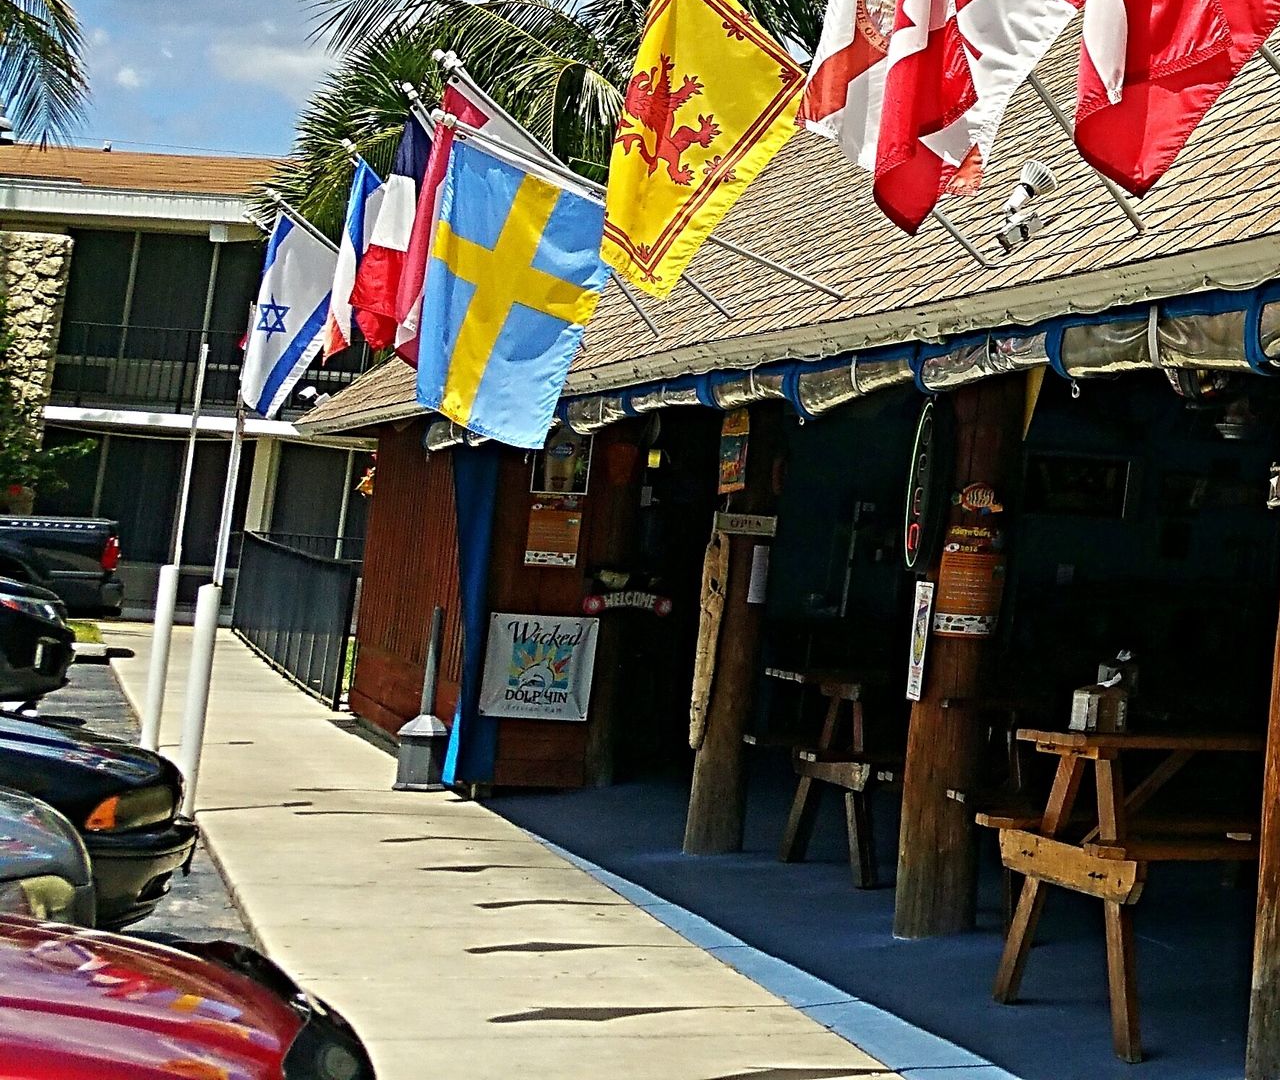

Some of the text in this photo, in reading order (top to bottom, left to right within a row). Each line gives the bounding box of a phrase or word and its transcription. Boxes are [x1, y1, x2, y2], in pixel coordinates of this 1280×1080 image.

[730, 518, 762, 529] OPEN
[602, 591, 657, 609] WELCOME
[508, 621, 583, 649] Wicked
